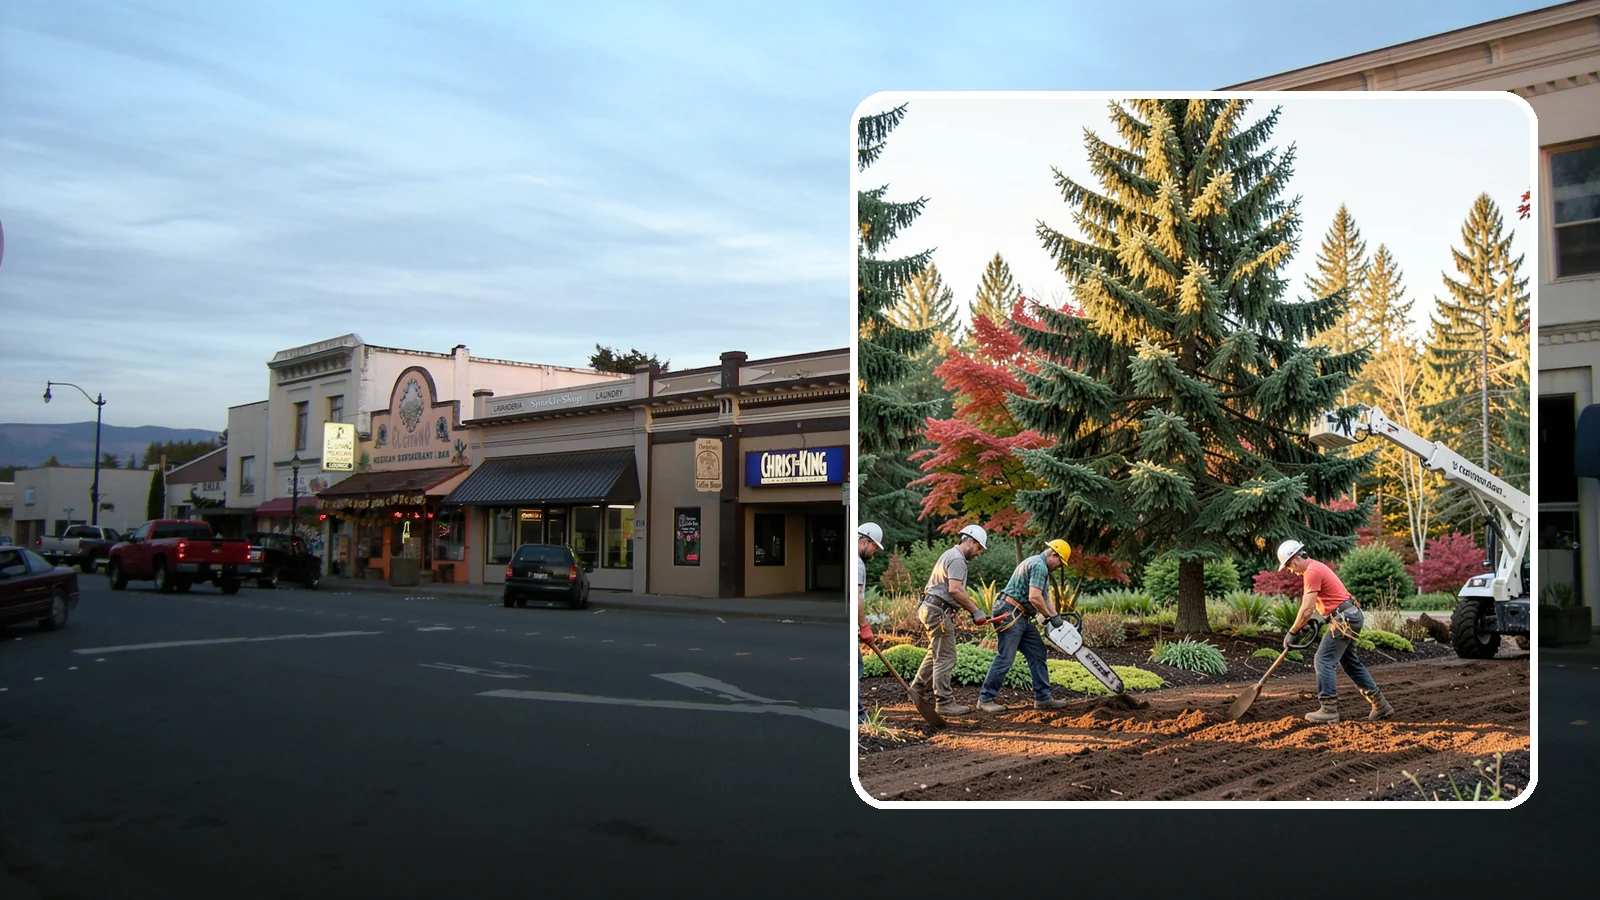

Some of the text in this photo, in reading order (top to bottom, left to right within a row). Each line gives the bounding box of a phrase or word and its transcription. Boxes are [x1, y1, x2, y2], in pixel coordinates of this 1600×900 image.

[493, 389, 624, 413] LAVANDERIA Sparkle Shop LAUNDRY
[373, 455, 395, 464] MEXICAN
[397, 451, 434, 462] RESTAURANT
[437, 450, 450, 459] BAR
[761, 450, 827, 477] CHRIST KING
[696, 480, 722, 489] Coffee House
